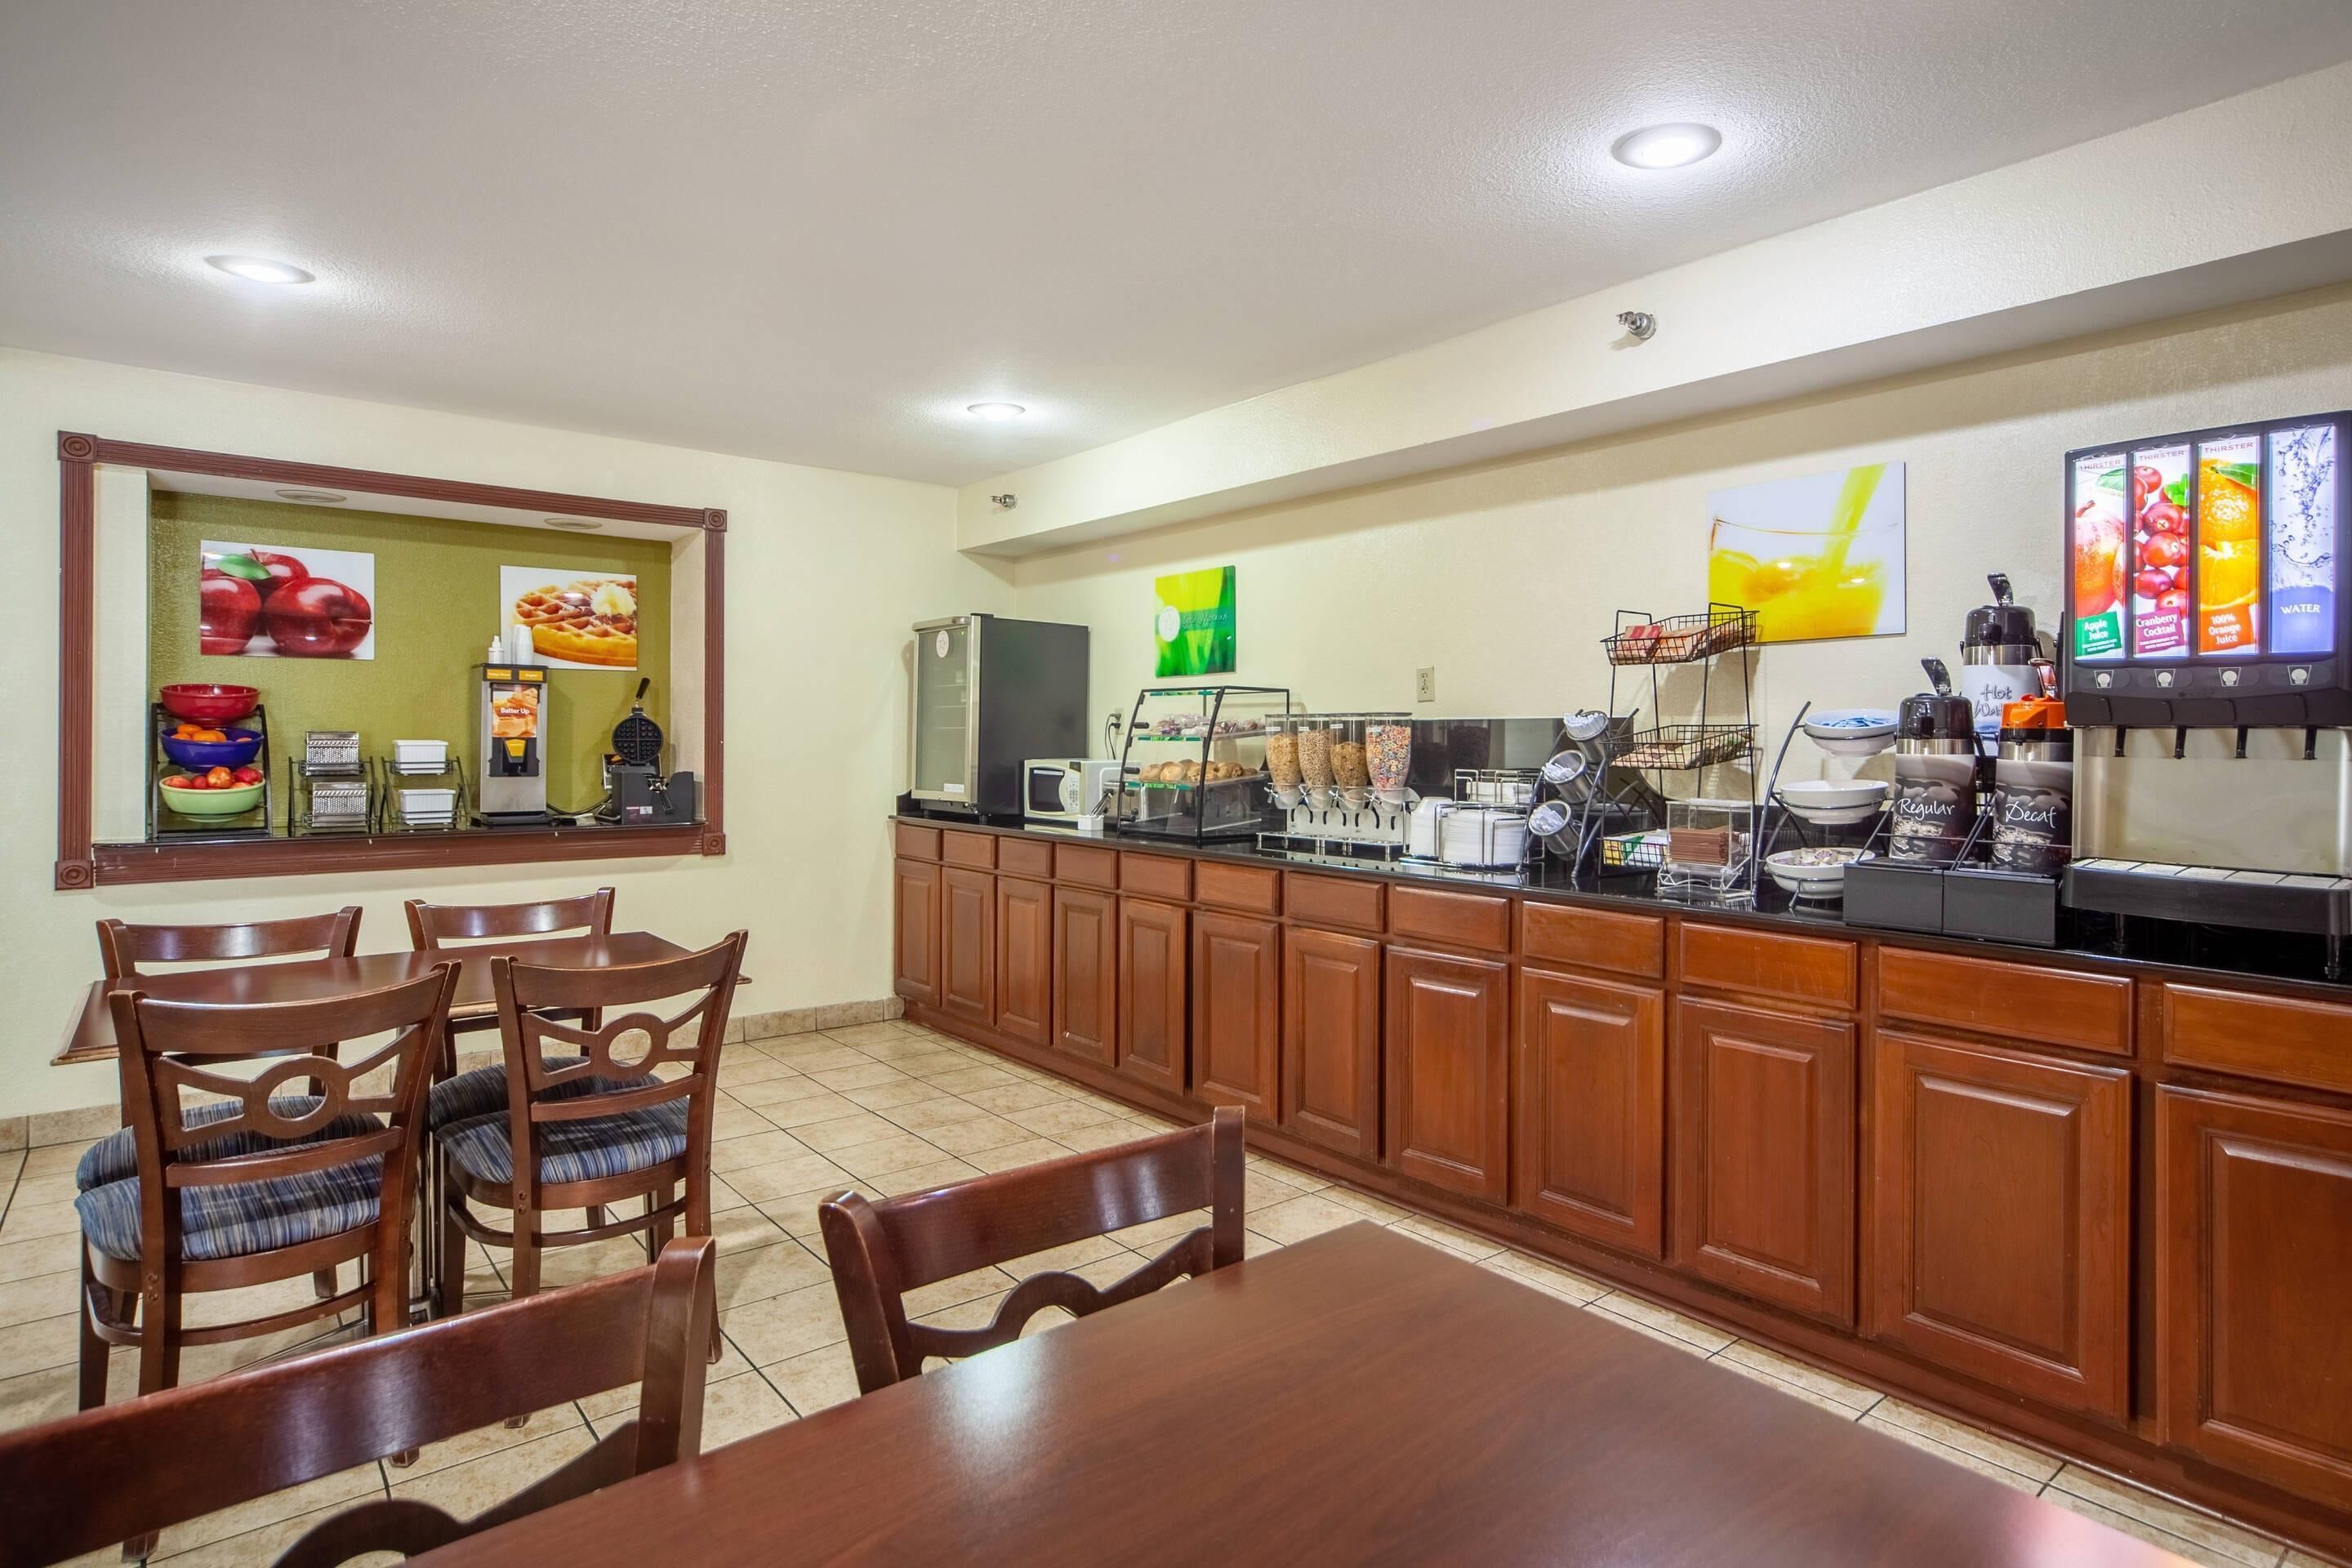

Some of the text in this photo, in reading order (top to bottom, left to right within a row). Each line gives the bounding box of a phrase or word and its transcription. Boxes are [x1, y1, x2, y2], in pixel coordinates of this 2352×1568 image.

[2205, 442, 2254, 453] THIRSTER
[2138, 449, 2185, 461] THIRSTER
[2280, 603, 2320, 615] WATER
[2136, 614, 2177, 628] Cranberry
[2210, 612, 2236, 625] 100%
[2084, 619, 2108, 632] Apple
[2143, 624, 2176, 637] Cocktail
[2208, 623, 2241, 636] Orange
[2088, 630, 2109, 640] Juice
[2215, 634, 2238, 645] Juice
[1980, 683, 2012, 702] Hot
[520, 707, 530, 715] Up
[1896, 798, 1955, 821] Regular
[2005, 800, 2057, 829] Decaf
